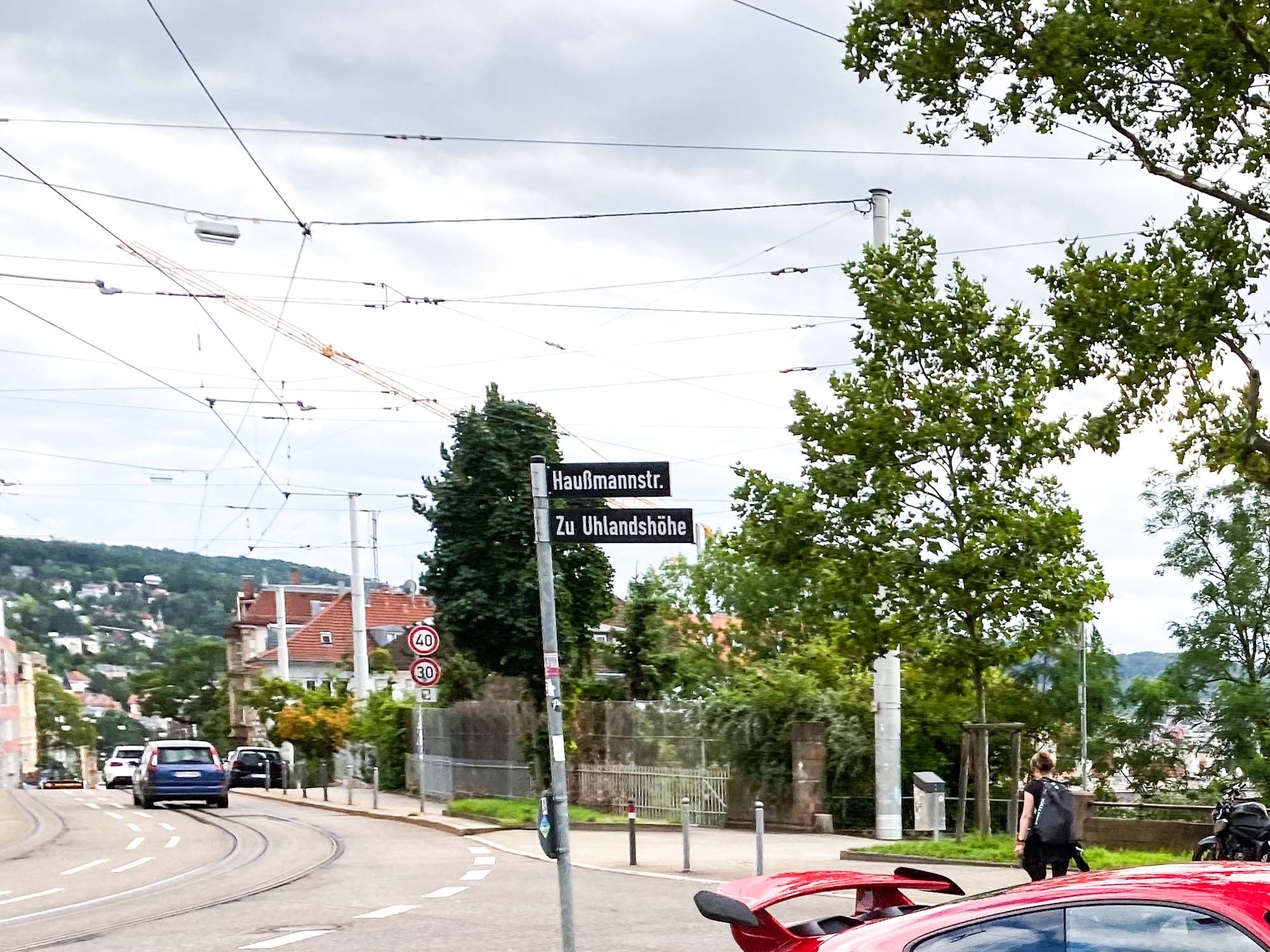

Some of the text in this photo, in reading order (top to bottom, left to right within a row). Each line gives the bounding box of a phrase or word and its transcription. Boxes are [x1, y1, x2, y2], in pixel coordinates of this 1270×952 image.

[552, 469, 664, 491] Haußmannstr.
[556, 514, 687, 536] Zu Uhlandshöhe
[415, 633, 433, 647] 40
[417, 665, 434, 679] 30
